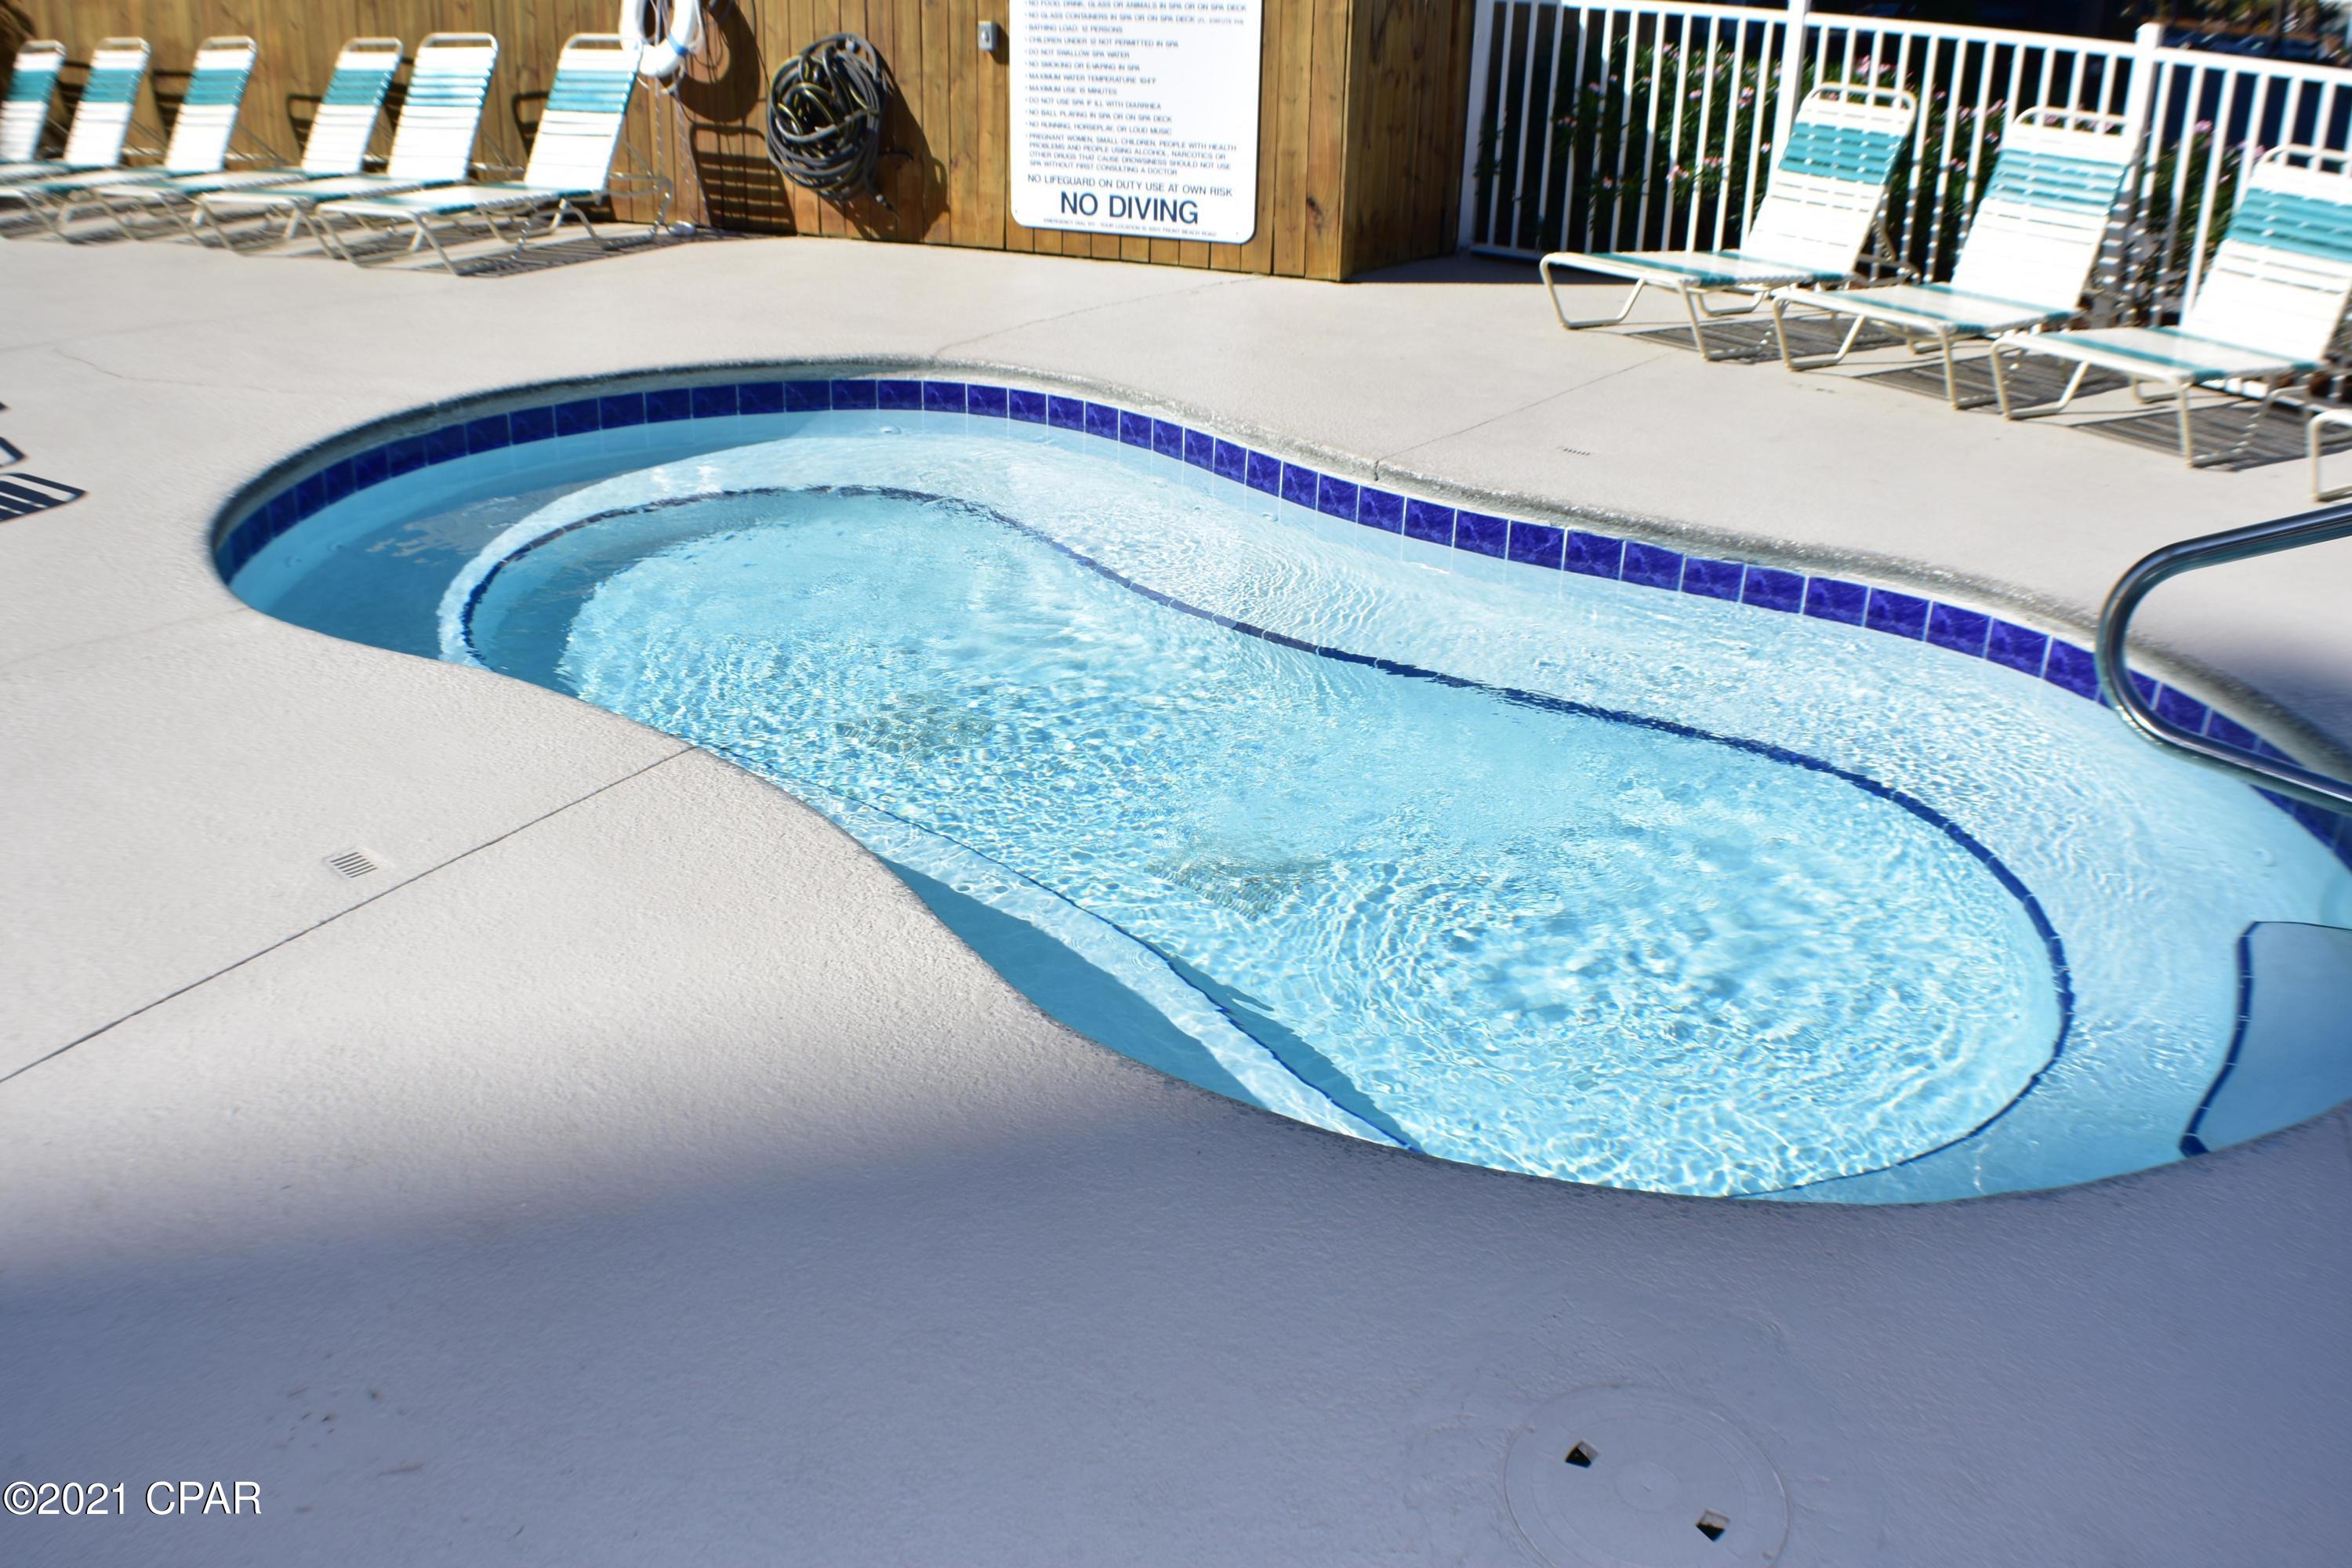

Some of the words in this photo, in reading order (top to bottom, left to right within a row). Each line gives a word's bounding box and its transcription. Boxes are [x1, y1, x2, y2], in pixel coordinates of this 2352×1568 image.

[1029, 35, 1062, 44] CHILDREN
[1115, 38, 1153, 46] PERMITTED
[1125, 100, 1161, 109] DIARRHEA
[1029, 132, 1064, 141] PREGNANT
[1029, 142, 1065, 151] PROBLEMS
[1122, 156, 1167, 165] DROWSINESS
[1044, 160, 1073, 169] WITHOUT
[1096, 163, 1138, 172] CONSULTING
[1147, 166, 1177, 175] DOCTOR
[1028, 173, 1041, 183] NO
[1044, 174, 1095, 187] LIFEGUARD
[1098, 178, 1112, 188] ON
[1116, 180, 1142, 190] DUTY
[1145, 181, 1164, 191] USE
[1168, 183, 1178, 192] AT
[1182, 183, 1206, 194] OWN
[1210, 185, 1232, 196] RISK
[1061, 191, 1098, 216] NO
[1109, 194, 1198, 223] DIVING
